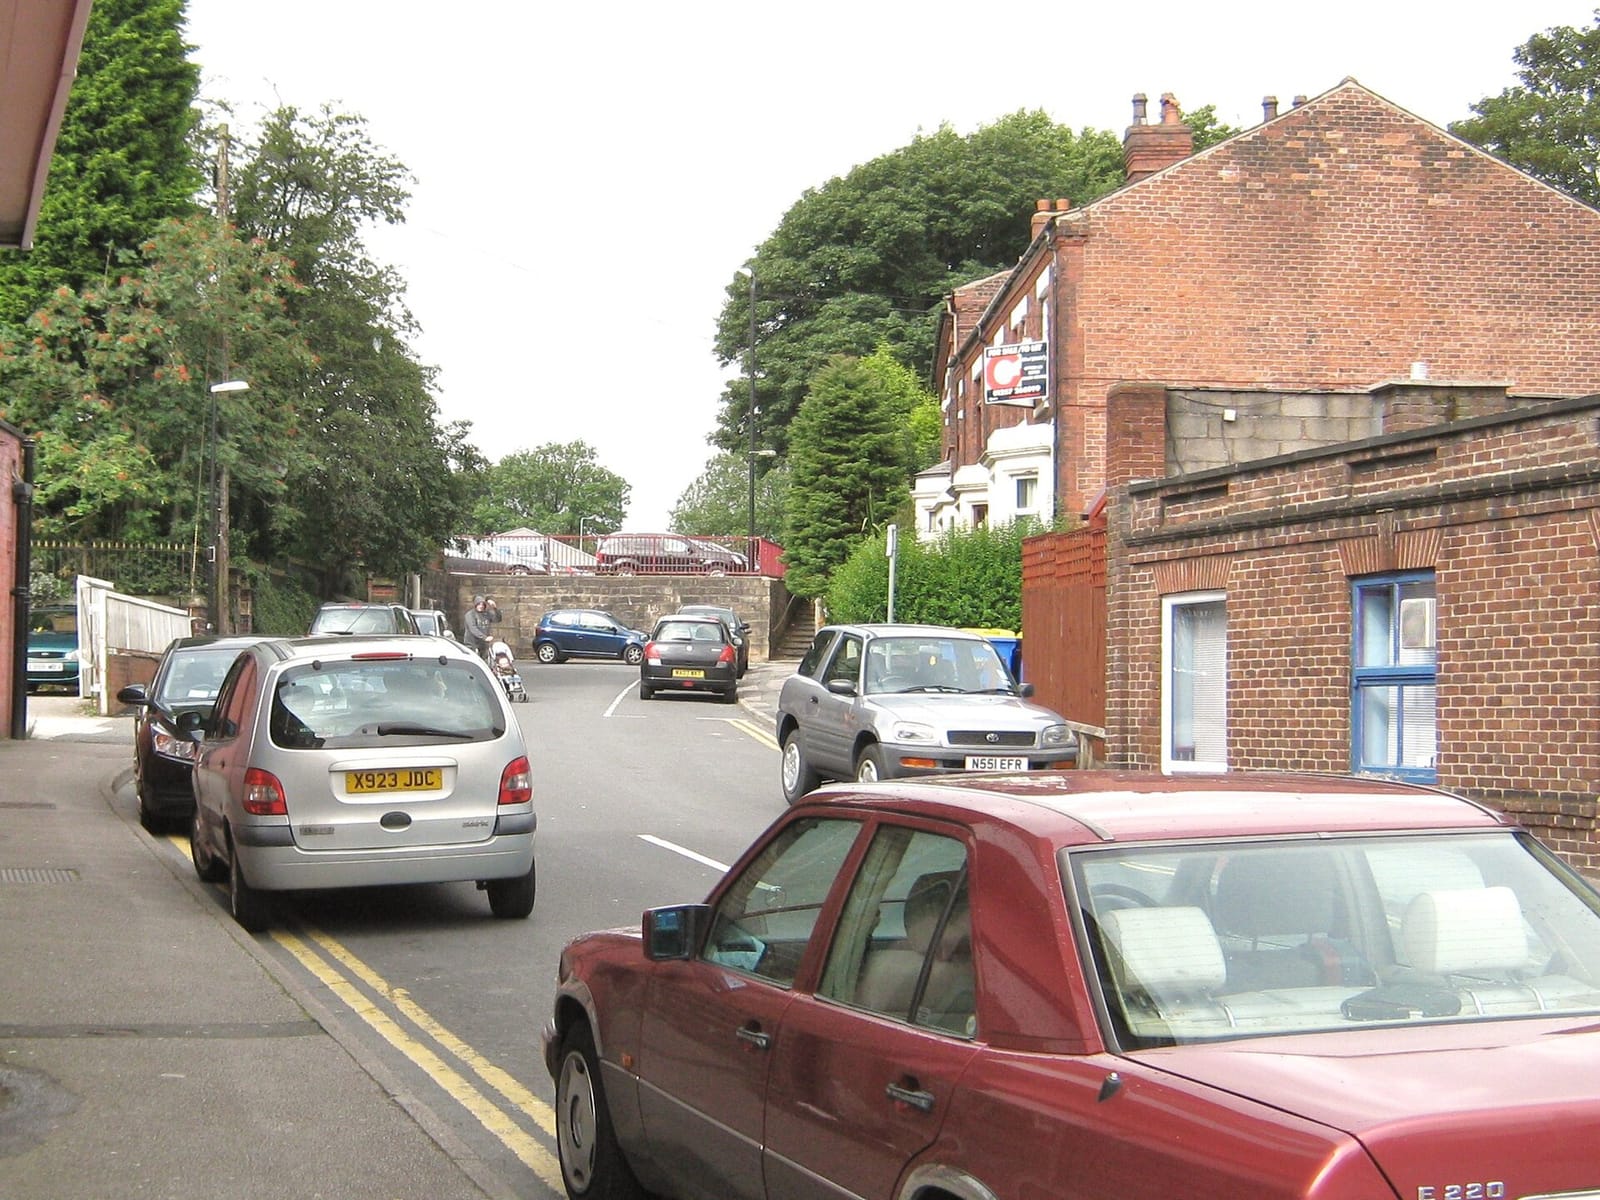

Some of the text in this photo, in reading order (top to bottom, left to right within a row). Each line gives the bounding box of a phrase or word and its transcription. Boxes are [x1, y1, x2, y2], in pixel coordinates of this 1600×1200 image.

[972, 758, 1022, 770] N551 EFR
[354, 771, 434, 789] X923 JDC
[1418, 1182, 1504, 1200] E 220
